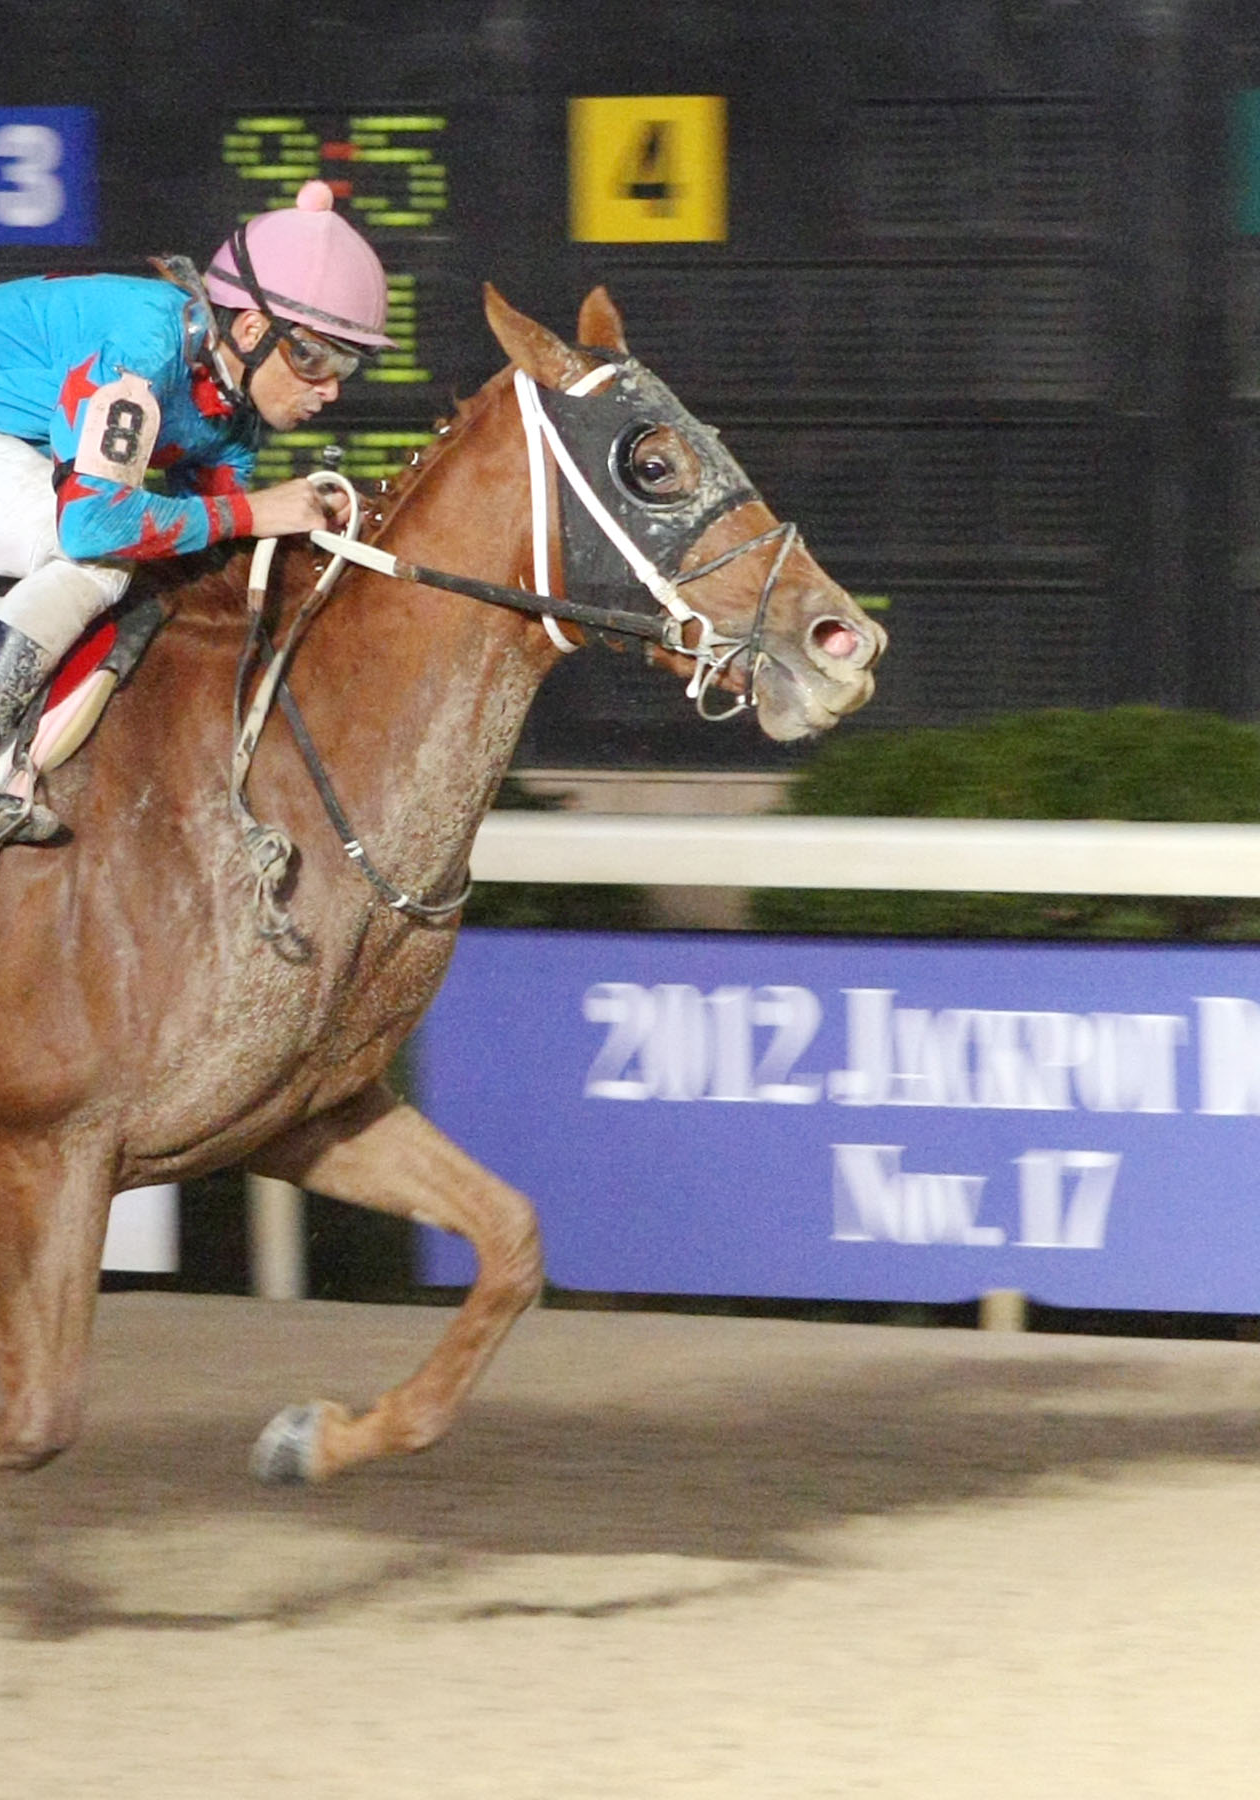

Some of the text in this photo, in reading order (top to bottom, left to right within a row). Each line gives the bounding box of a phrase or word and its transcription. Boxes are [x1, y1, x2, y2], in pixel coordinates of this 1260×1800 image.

[613, 120, 685, 219] 4
[100, 398, 144, 464] 8
[582, 982, 824, 1106] 2012
[1010, 1148, 1123, 1250] 17
